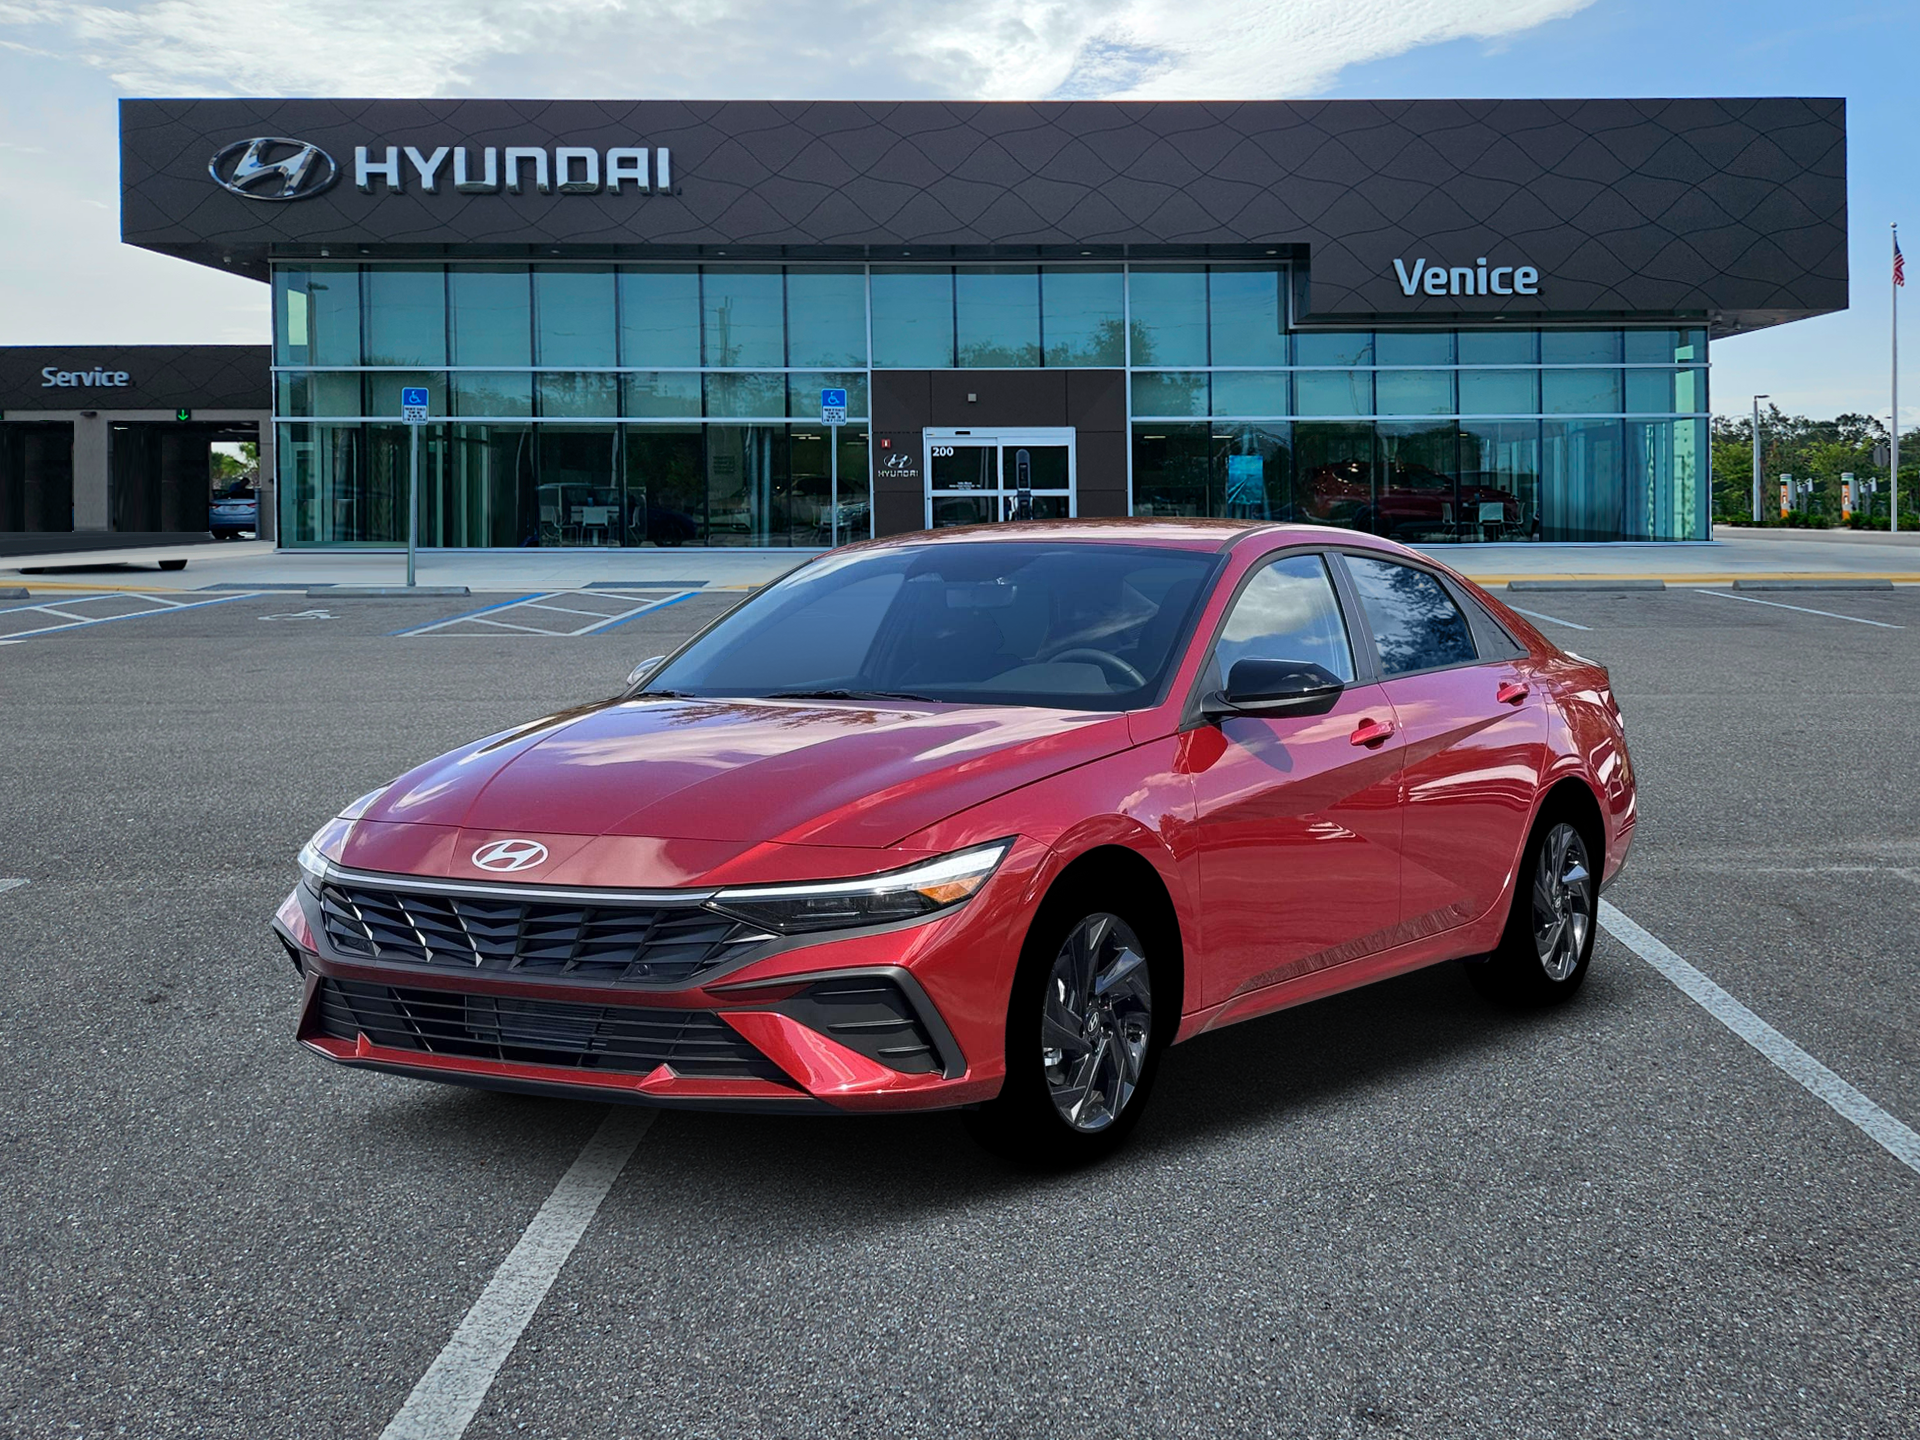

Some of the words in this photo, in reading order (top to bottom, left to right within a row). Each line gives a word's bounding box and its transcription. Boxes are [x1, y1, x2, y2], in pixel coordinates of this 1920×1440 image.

[355, 146, 671, 193] HYUNDAI
[1393, 257, 1539, 295] Venice
[41, 366, 130, 387] Service
[932, 447, 954, 456] 200
